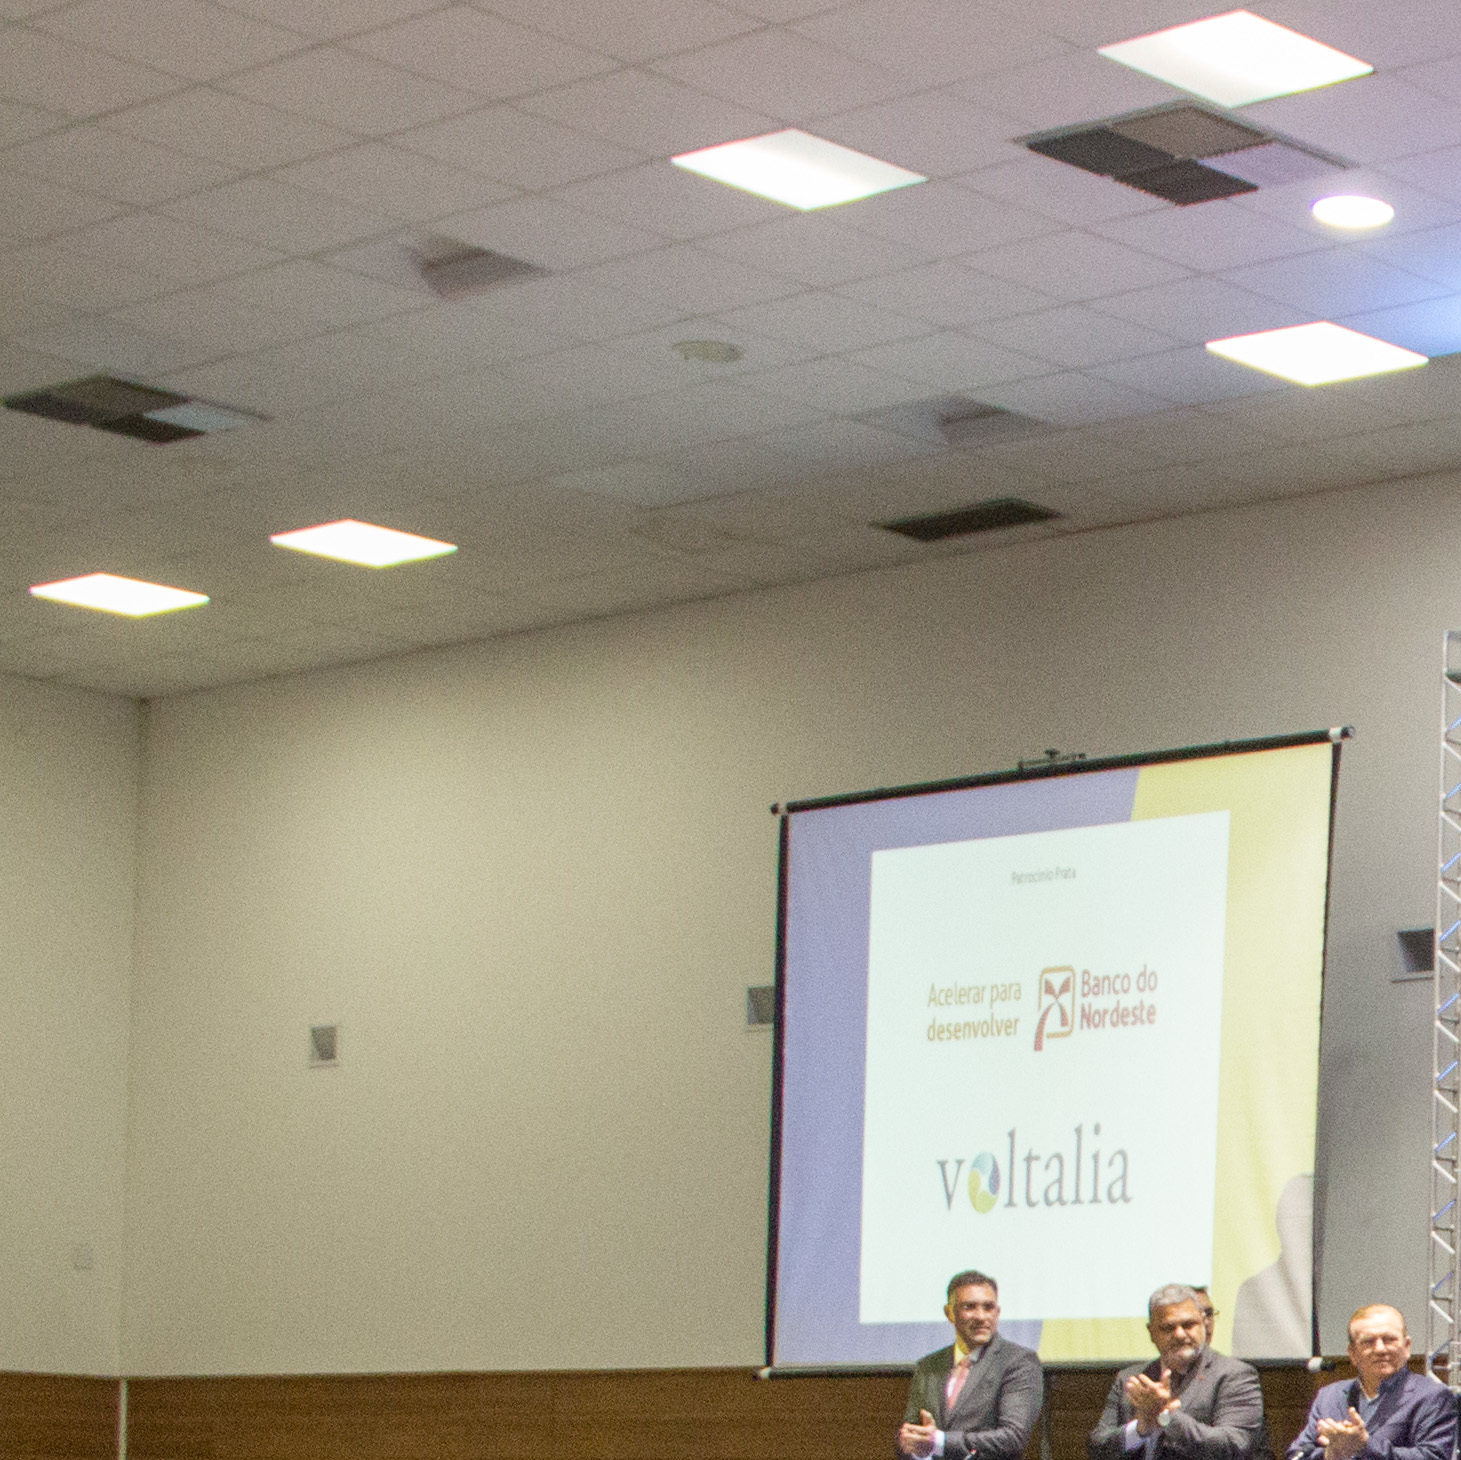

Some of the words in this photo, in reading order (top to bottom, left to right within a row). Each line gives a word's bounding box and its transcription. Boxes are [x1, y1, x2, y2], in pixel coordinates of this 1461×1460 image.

[928, 983, 986, 1008] Acelerar
[990, 980, 1022, 1006] para
[1080, 969, 1131, 998] Banco
[1136, 964, 1158, 992] do
[927, 1014, 1019, 1043] desenvolver
[1080, 999, 1157, 1031] Nordeste
[936, 1121, 1133, 1214] voltalia
